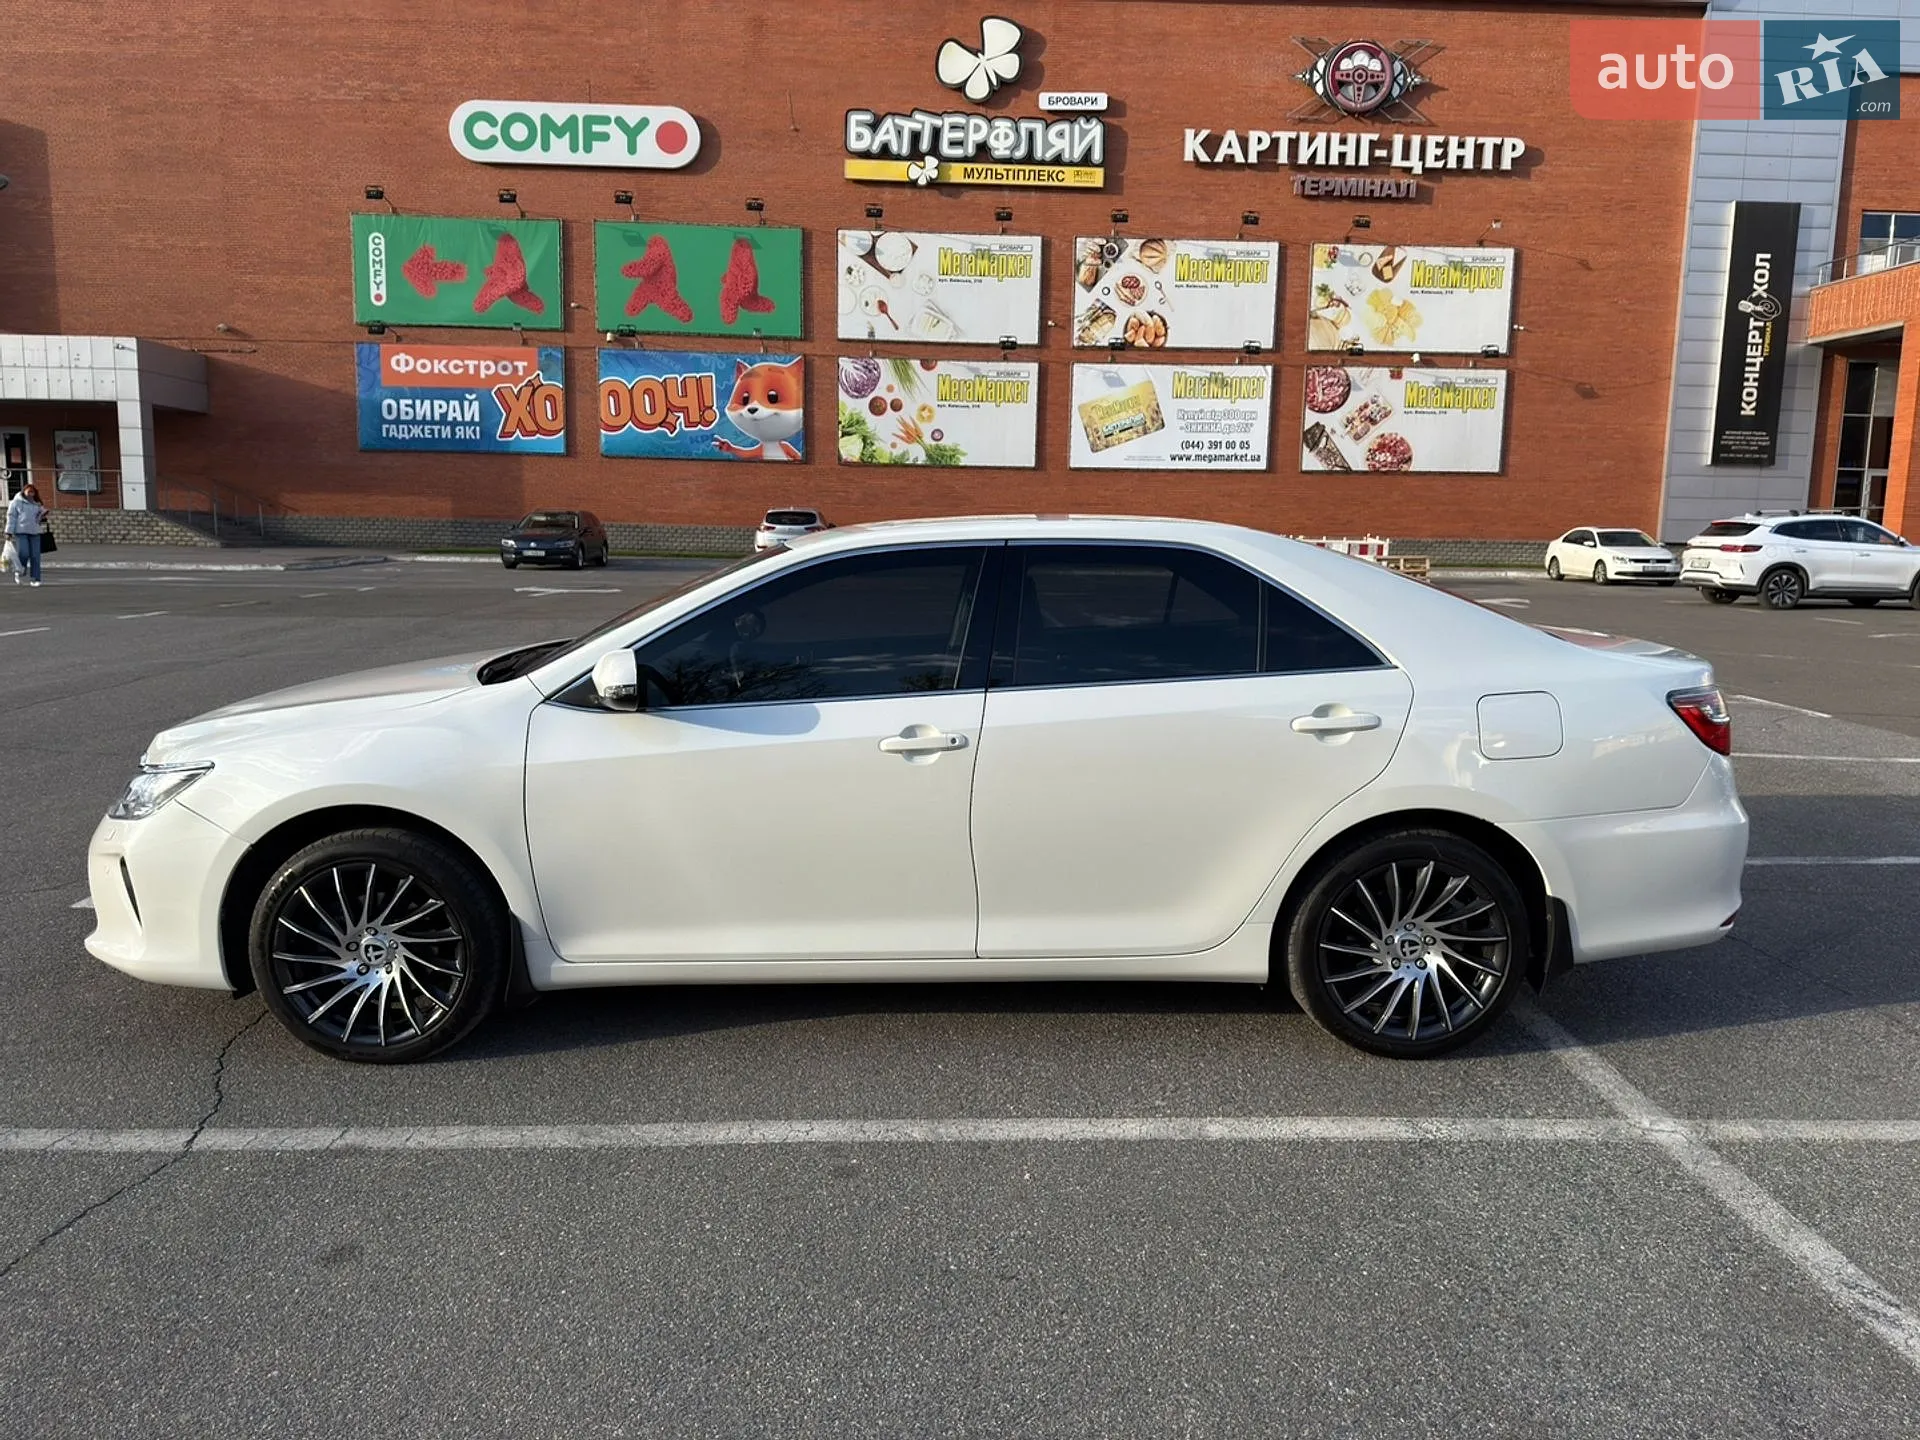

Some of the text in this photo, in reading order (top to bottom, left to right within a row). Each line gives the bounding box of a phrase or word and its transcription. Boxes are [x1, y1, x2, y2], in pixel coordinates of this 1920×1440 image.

[1047, 96, 1098, 107] БРОВАРИ
[463, 110, 650, 156] COMFY
[846, 109, 1104, 165] БАТТЕРФЛЯЙ
[1183, 128, 1526, 175] КАРТИНГ-ЦЕНТР
[962, 167, 1066, 183] МУЛЬТІПЛЕКС
[1291, 175, 1417, 198] ТЕРМІНАЛ
[372, 235, 383, 291] COMFY
[939, 247, 1032, 282] МегаМаркет
[1175, 253, 1269, 287] МегаМаркет
[1411, 259, 1505, 293] МегаМаркет
[1752, 253, 1771, 298] ХОЛ
[390, 352, 528, 379] Фокстрот
[1740, 317, 1765, 416] КОНЦЕРТ
[600, 374, 718, 431] ООЧ!
[937, 373, 1030, 407] МегаМаркет
[1173, 371, 1266, 404] МегаМаркет
[1405, 381, 1497, 413] МегаМаркет
[382, 393, 480, 422] ОБИРАЙ
[382, 424, 480, 440] ГАДЖЕТИ ЯКІ
[1181, 440, 1250, 451] (044) 391 00 05
[1169, 453, 1261, 464] www.megamarket.ua
